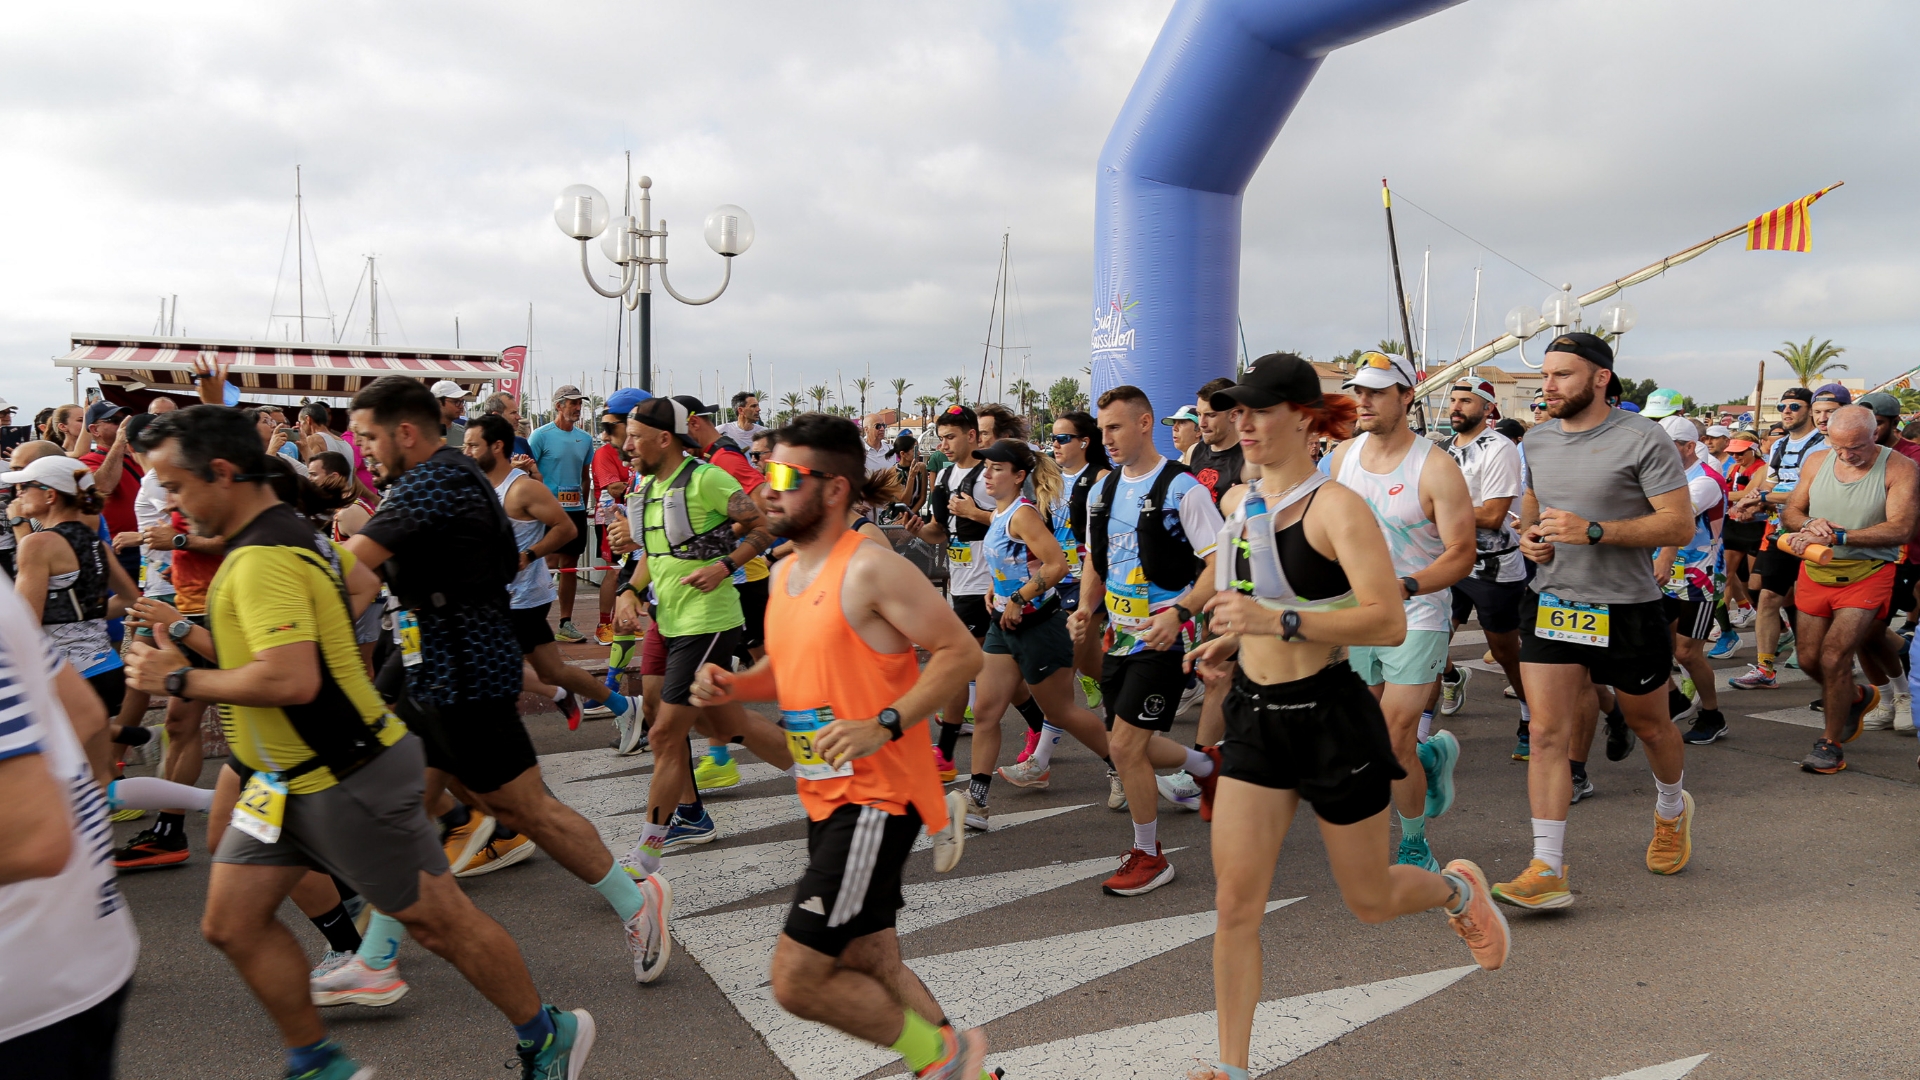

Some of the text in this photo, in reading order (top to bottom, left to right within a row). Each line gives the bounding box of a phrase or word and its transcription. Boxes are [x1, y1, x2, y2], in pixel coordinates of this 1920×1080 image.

[1094, 306, 1114, 332] Sud
[560, 493, 577, 501] 101
[1112, 595, 1132, 613] 73
[1550, 610, 1597, 632] 612
[241, 780, 270, 815] 22
[1172, 787, 1194, 796] KIPRUN
